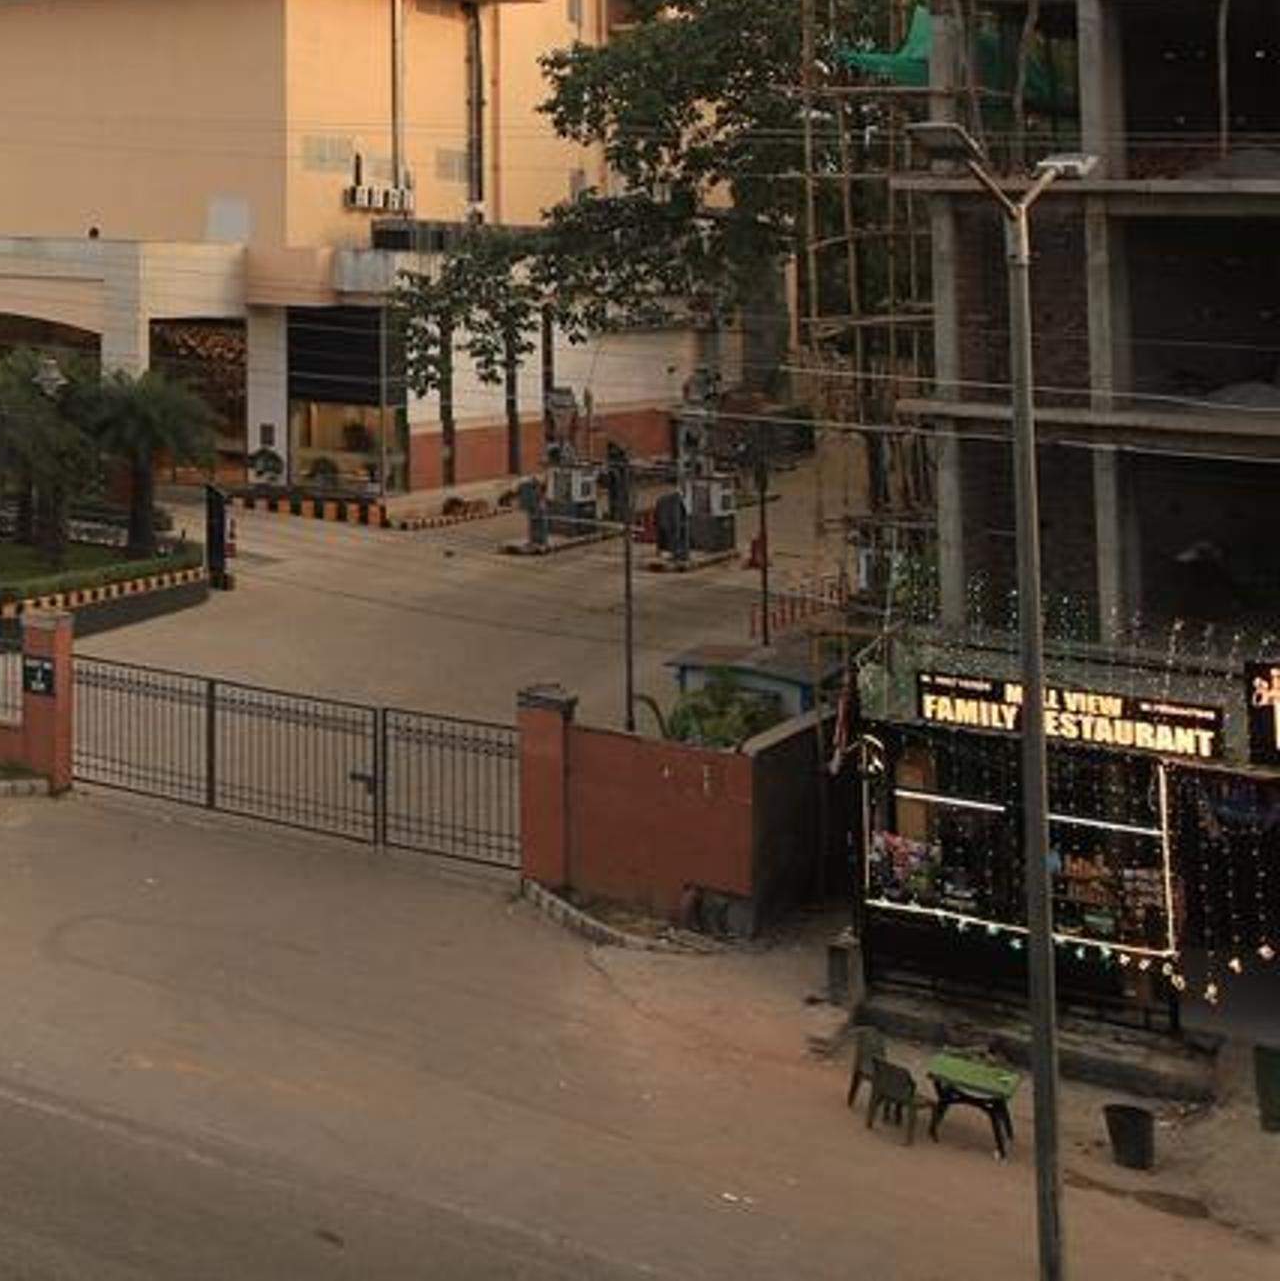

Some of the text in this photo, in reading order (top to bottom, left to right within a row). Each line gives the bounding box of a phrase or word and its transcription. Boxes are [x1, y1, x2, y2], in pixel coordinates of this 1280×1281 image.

[923, 692, 1214, 757] FAMILY ESTAURANT
[1004, 682, 1059, 709] MLL
[1063, 691, 1122, 718] VIEW
